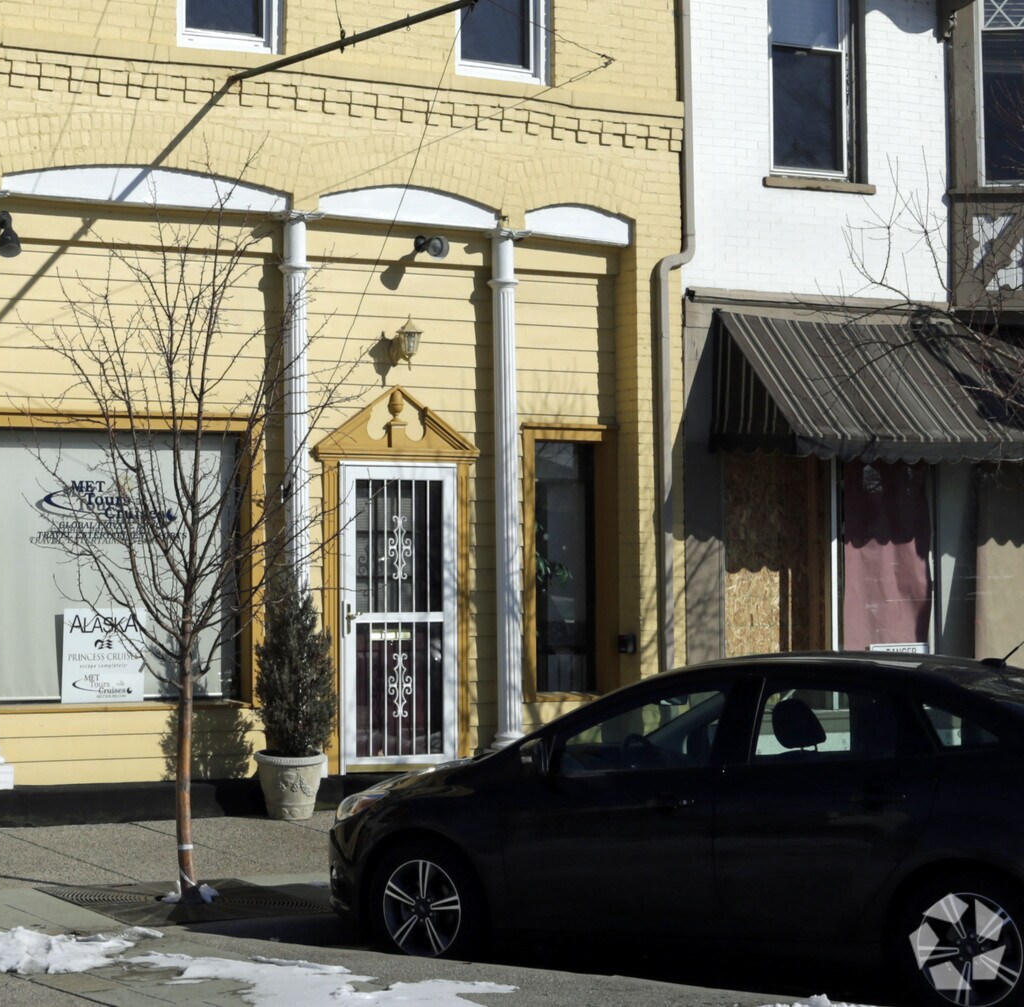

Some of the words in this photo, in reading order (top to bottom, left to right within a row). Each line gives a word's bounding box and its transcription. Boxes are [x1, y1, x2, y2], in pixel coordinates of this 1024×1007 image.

[71, 480, 106, 493] MET
[69, 614, 139, 634] ALASKA
[68, 653, 105, 662] PRINCESS
[84, 674, 100, 682] MET
